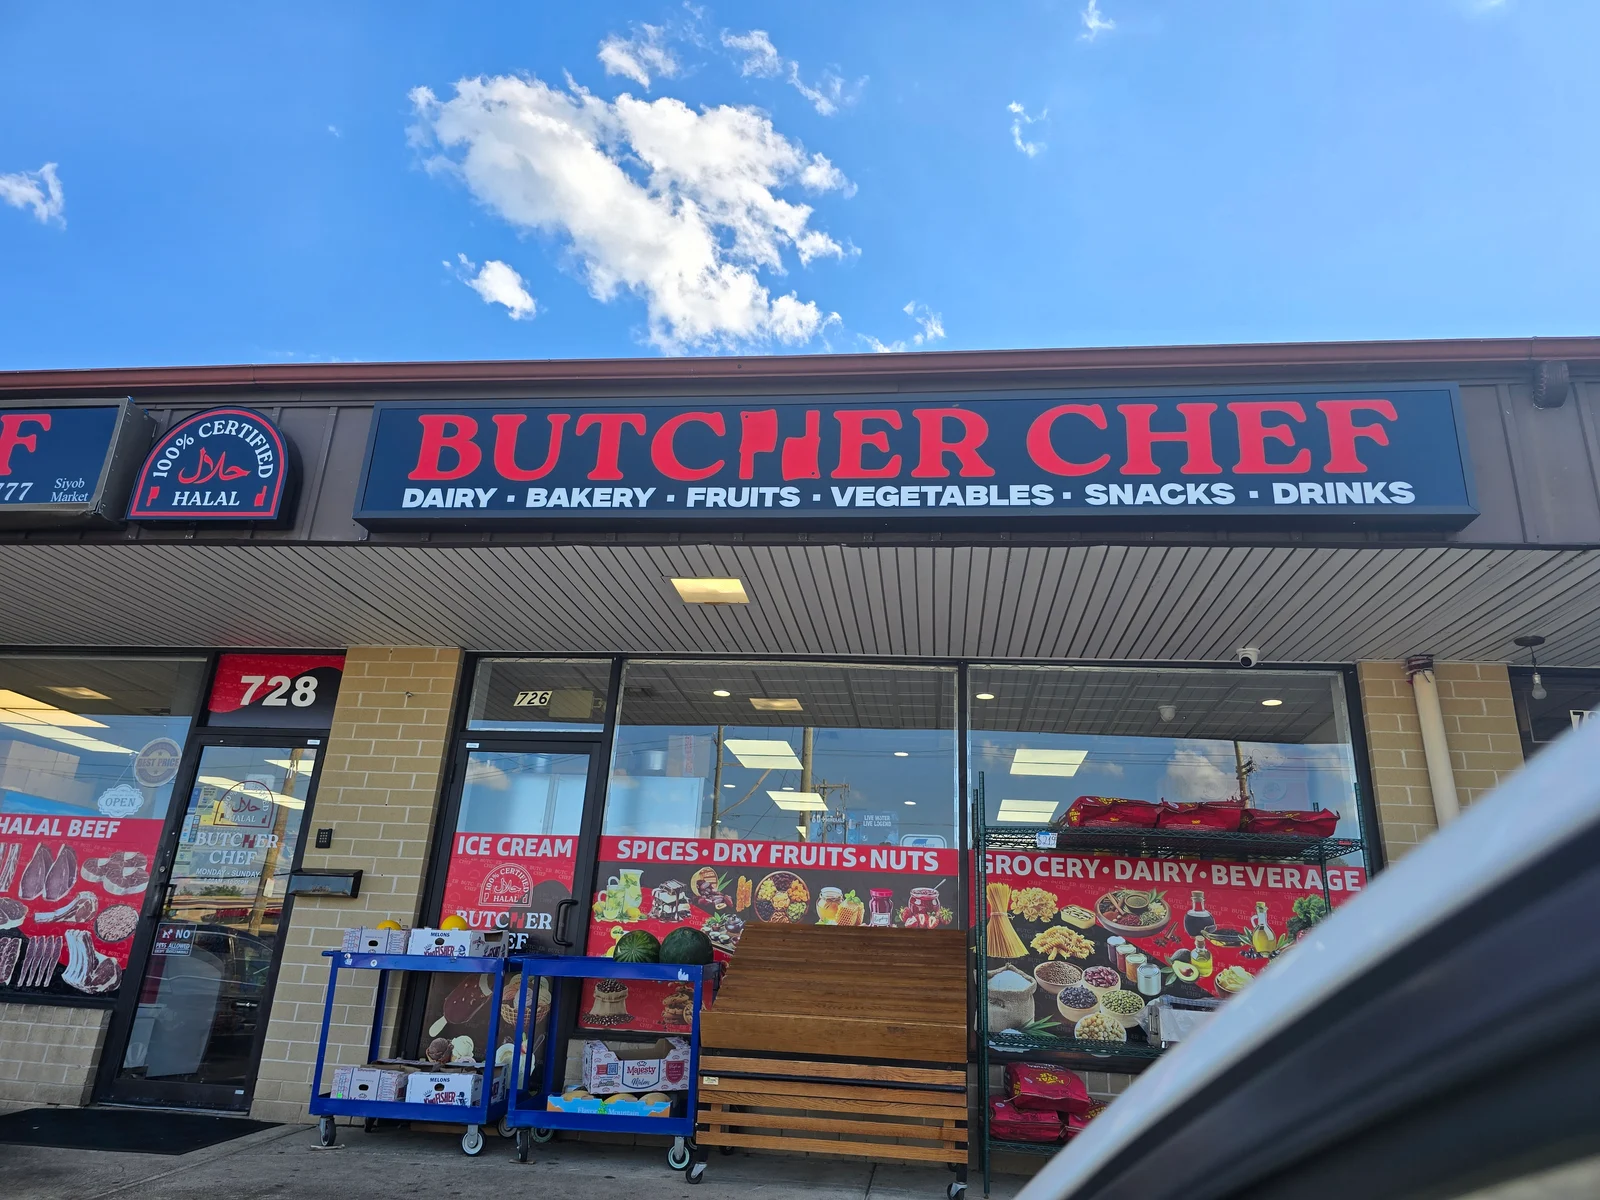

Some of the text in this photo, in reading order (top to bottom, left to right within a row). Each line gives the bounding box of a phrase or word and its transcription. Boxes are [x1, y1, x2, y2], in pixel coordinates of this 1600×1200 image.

[1026, 399, 1398, 476] CHEF
[153, 420, 273, 478] 100% CERTIFIED
[178, 447, 250, 484] حلال
[54, 478, 85, 491] Siyob
[50, 491, 89, 502] Market
[172, 491, 240, 506] HALAL
[402, 481, 1415, 508] DAIRY BAKERY FRUITS VEGETABLES SNACKS DRINKS
[240, 675, 318, 707] 728
[517, 692, 550, 705] 726
[158, 757, 179, 767] PRICE
[105, 797, 136, 807] OPEN
[0, 816, 121, 838] HALAL BEEF
[457, 836, 573, 857] ICE CREAM
[617, 840, 938, 871] SPICES DRY FRUITS NUTS
[209, 850, 258, 866] CHEF
[195, 867, 262, 878] MONDAY SUNDAY
[485, 868, 529, 892] 100% CERTIFIED
[979, 854, 1361, 892] GROCERY DAIRY BEVERAGE
[175, 929, 190, 939] NO
[626, 1066, 656, 1076] Majesty
